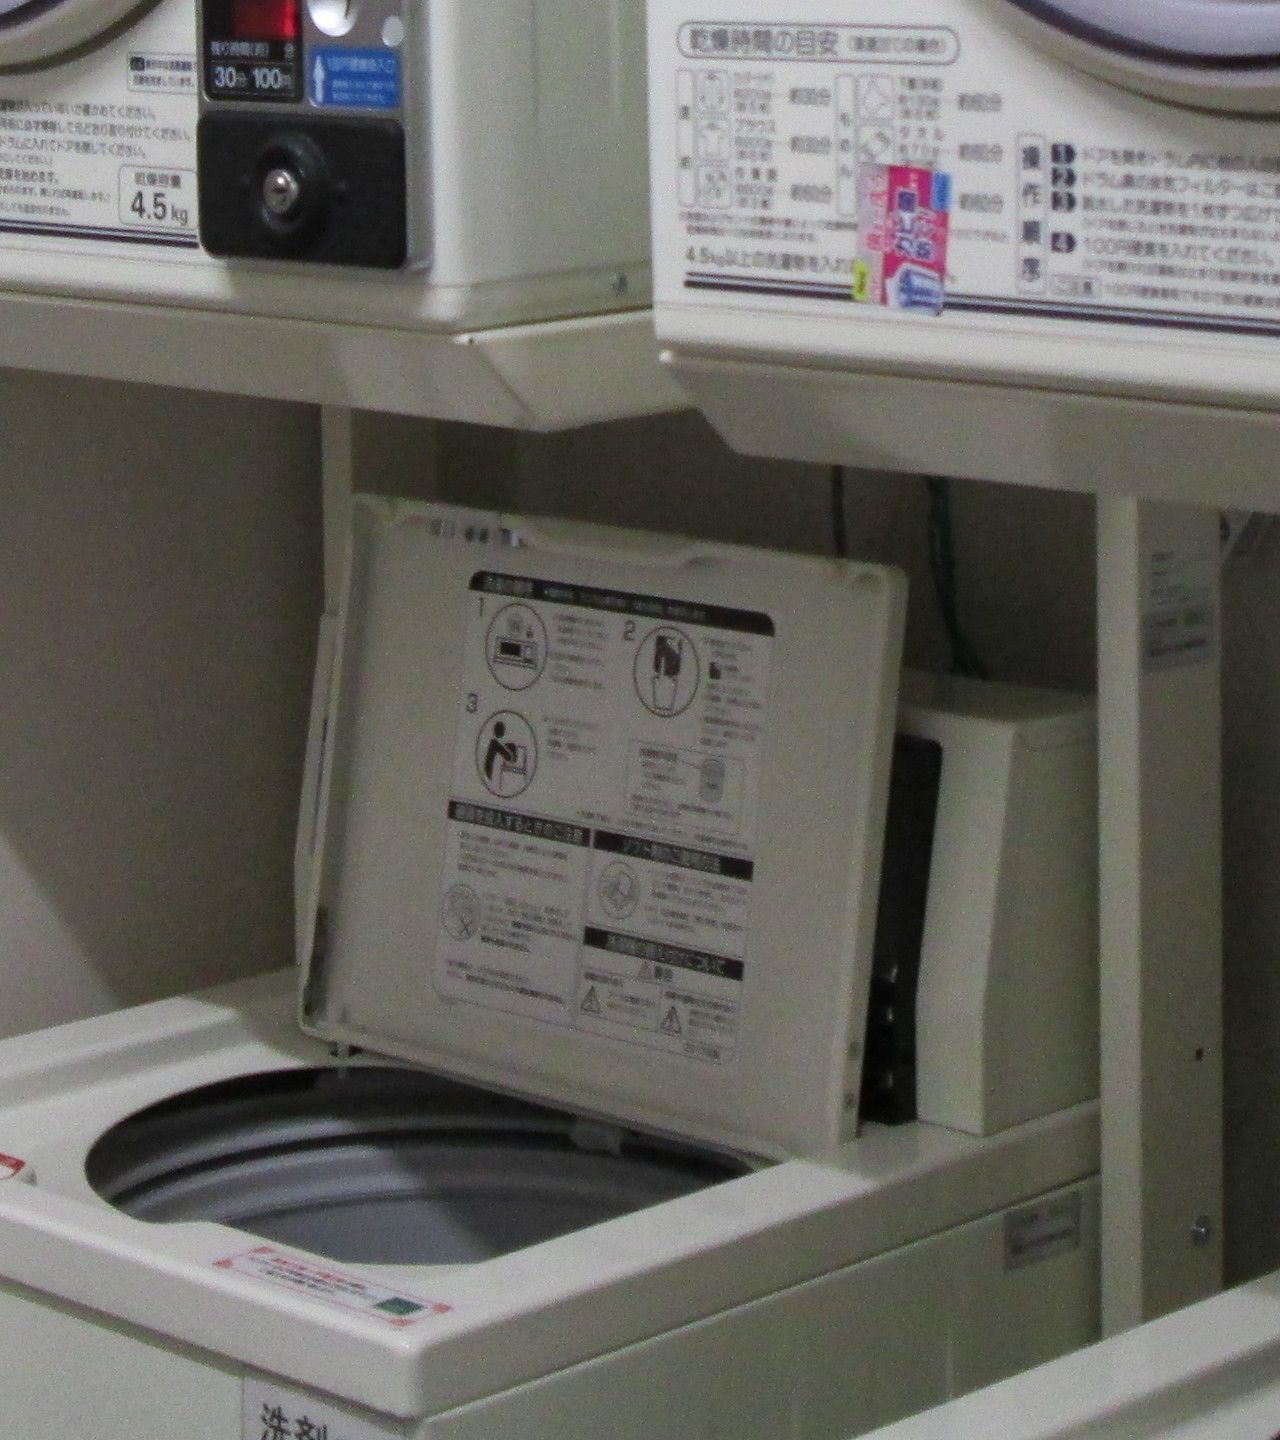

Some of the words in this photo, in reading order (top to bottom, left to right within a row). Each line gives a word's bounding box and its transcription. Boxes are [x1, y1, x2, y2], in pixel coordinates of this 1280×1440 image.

[689, 28, 839, 57] 乾燥時間の目安
[623, 619, 637, 642] 2
[465, 693, 479, 714] 3
[261, 1403, 328, 1440] 洗剤
